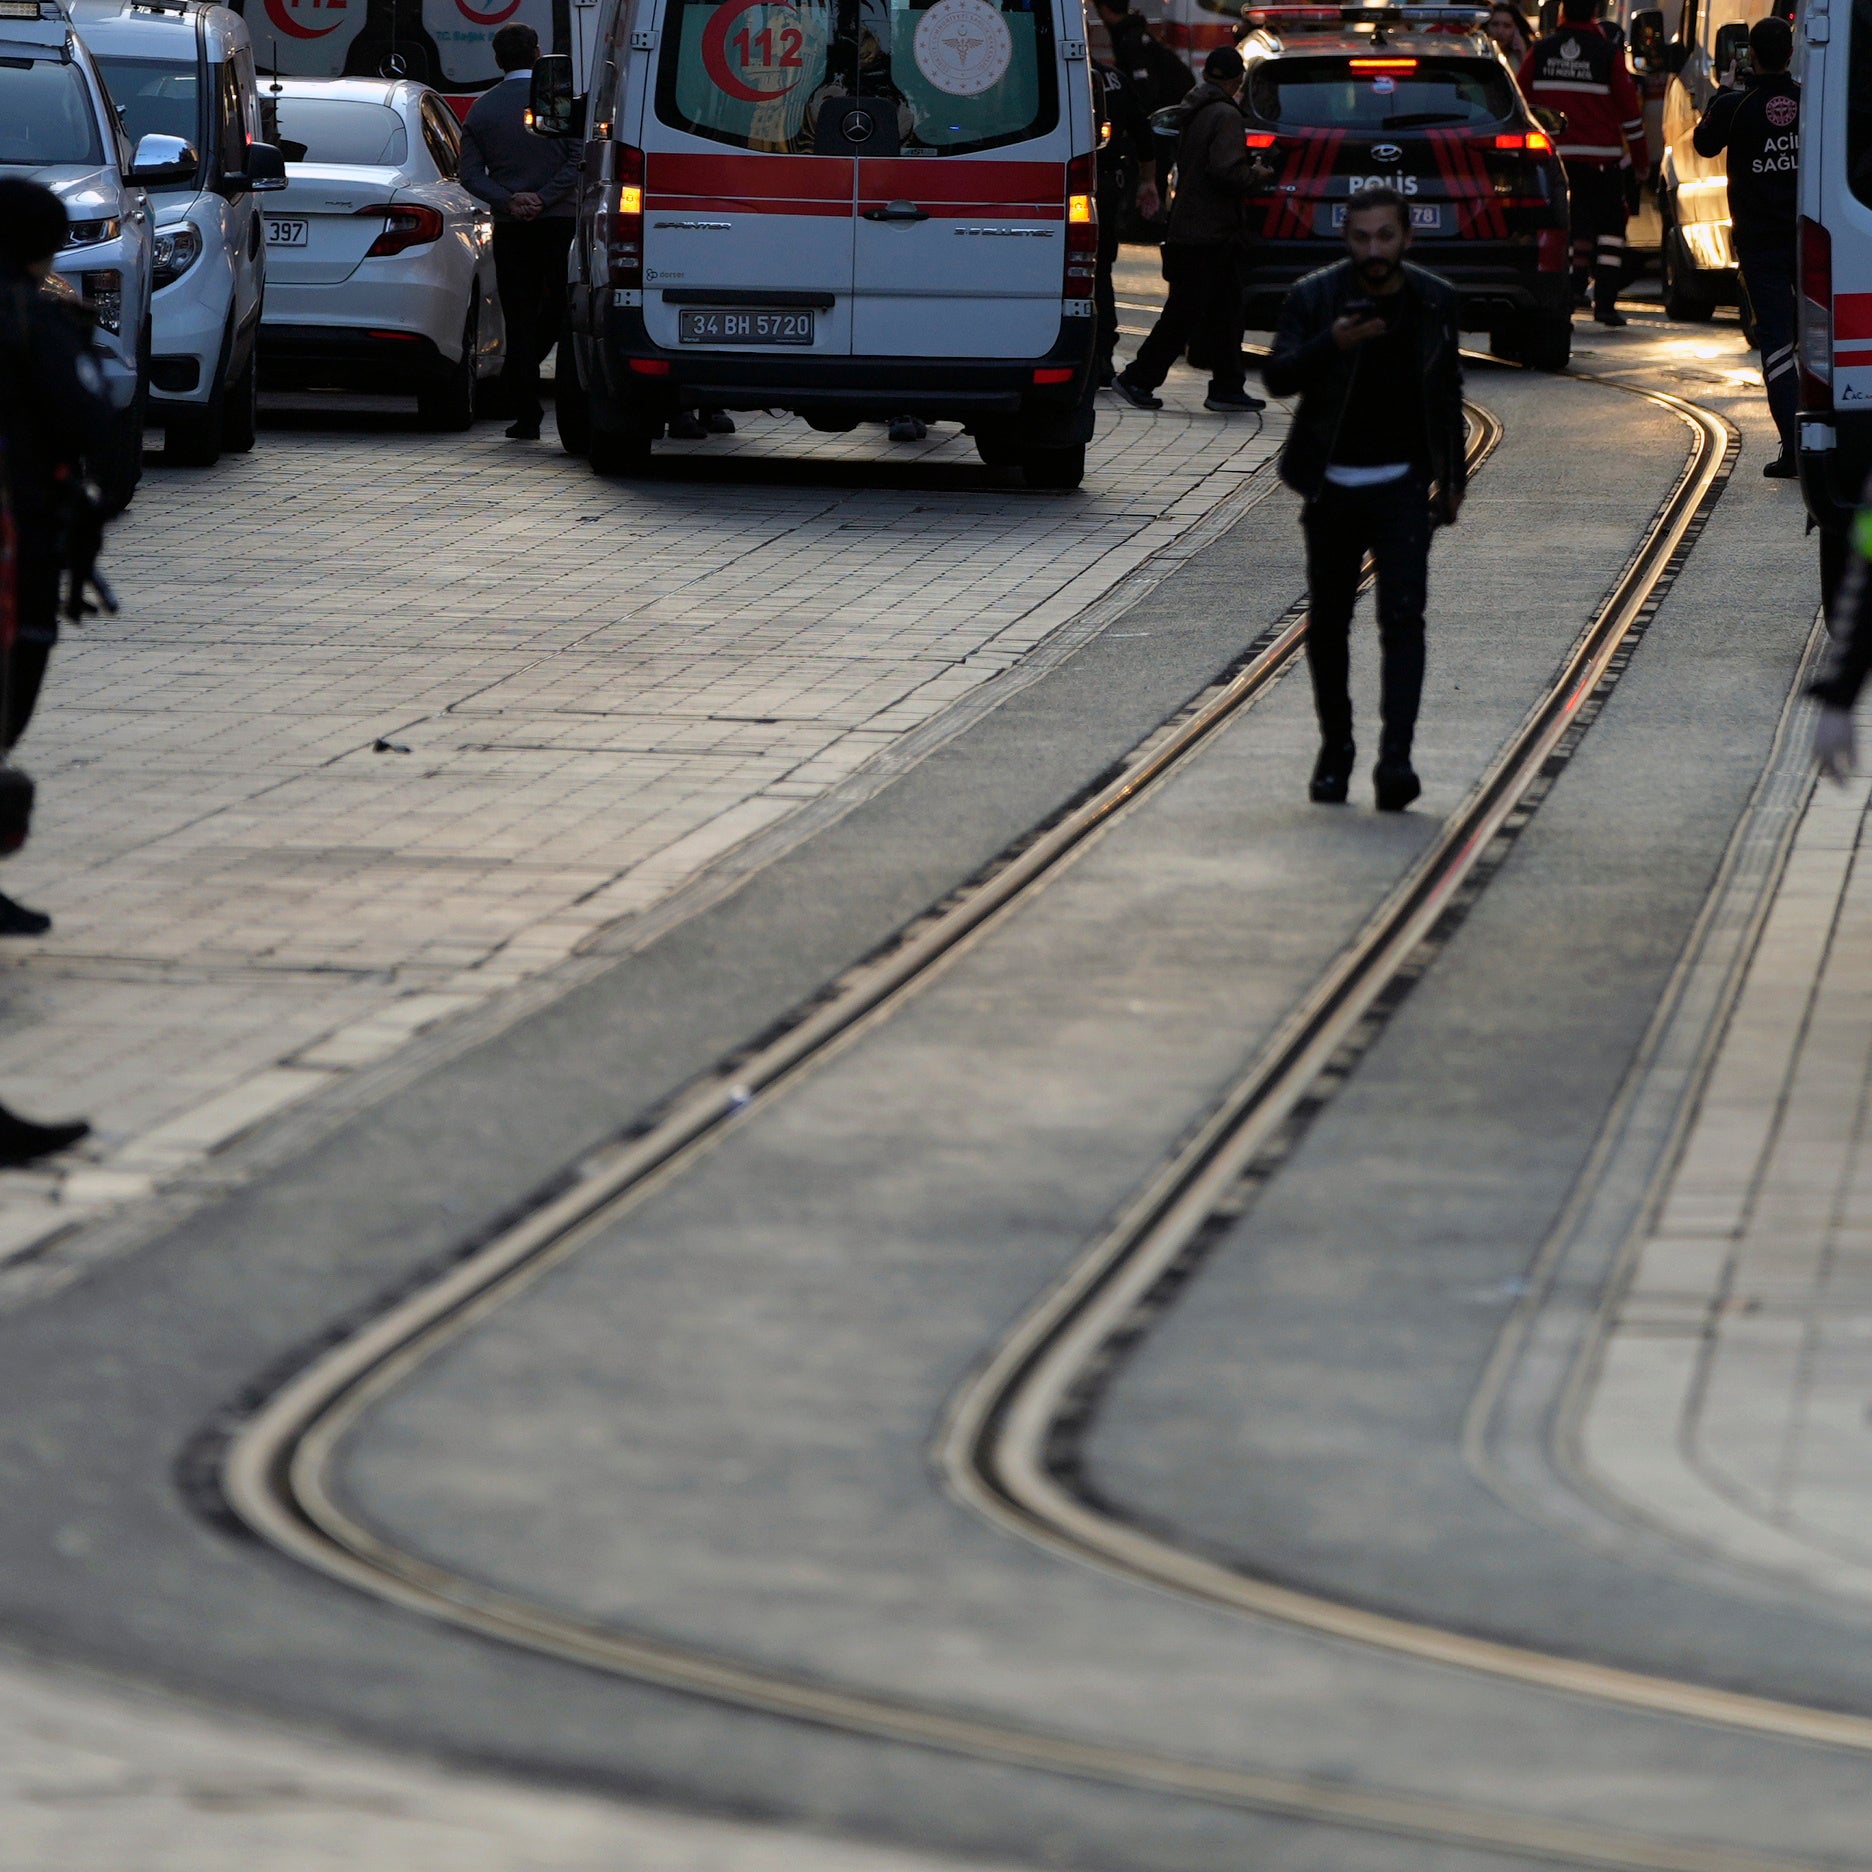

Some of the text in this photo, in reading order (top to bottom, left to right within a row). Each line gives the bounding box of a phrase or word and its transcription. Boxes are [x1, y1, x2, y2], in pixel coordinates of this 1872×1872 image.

[732, 27, 803, 67] 112
[1752, 152, 1799, 175] SAĞL
[269, 221, 304, 243] 397
[693, 315, 810, 336] 34 BH 5720
